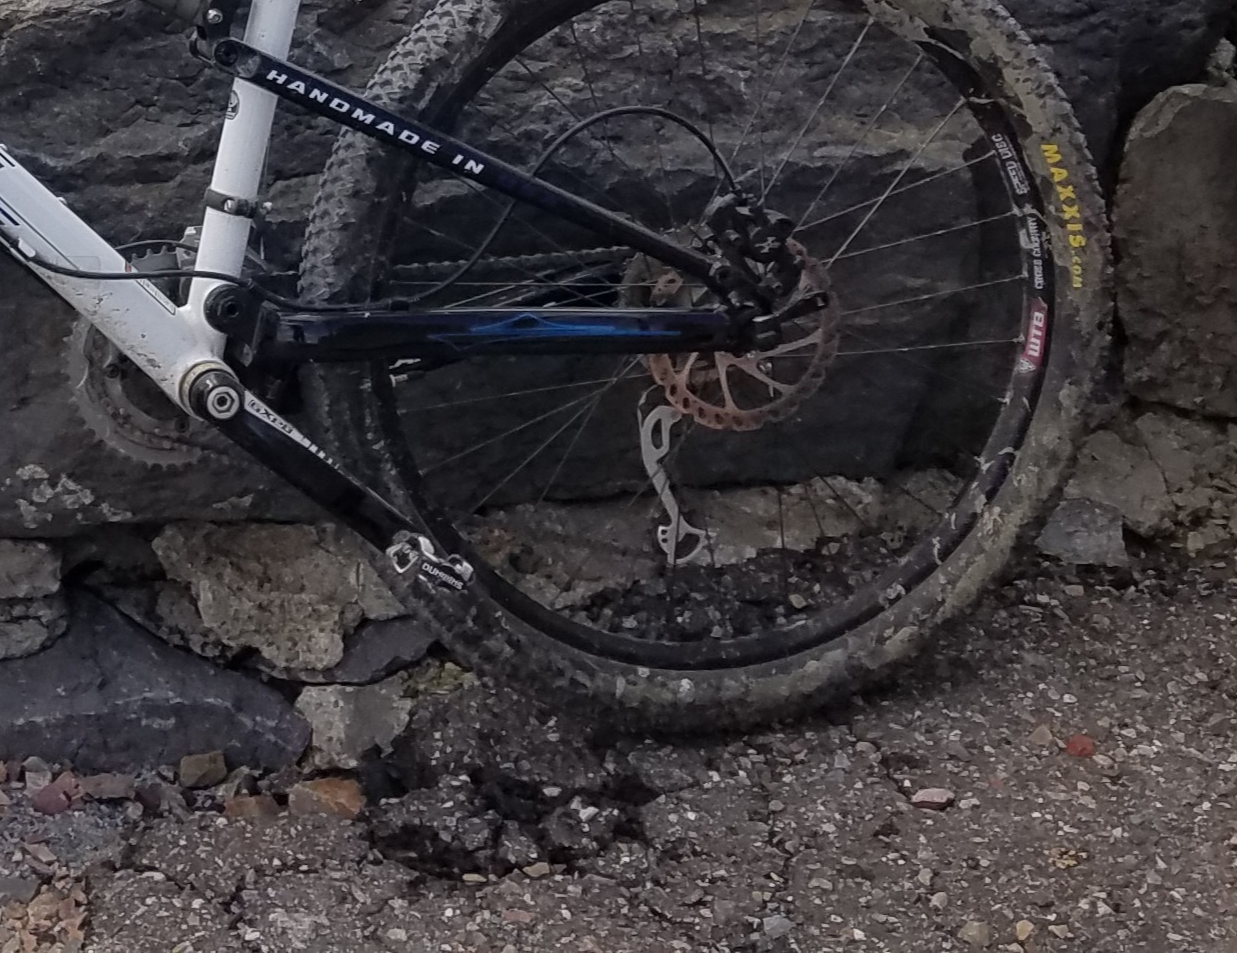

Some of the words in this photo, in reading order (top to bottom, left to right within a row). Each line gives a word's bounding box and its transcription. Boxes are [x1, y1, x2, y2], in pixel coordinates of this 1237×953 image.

[265, 69, 442, 155] HANDMADE
[451, 153, 485, 175] IN
[1028, 312, 1045, 357] WTB
[422, 562, 463, 590] SHIMANO
